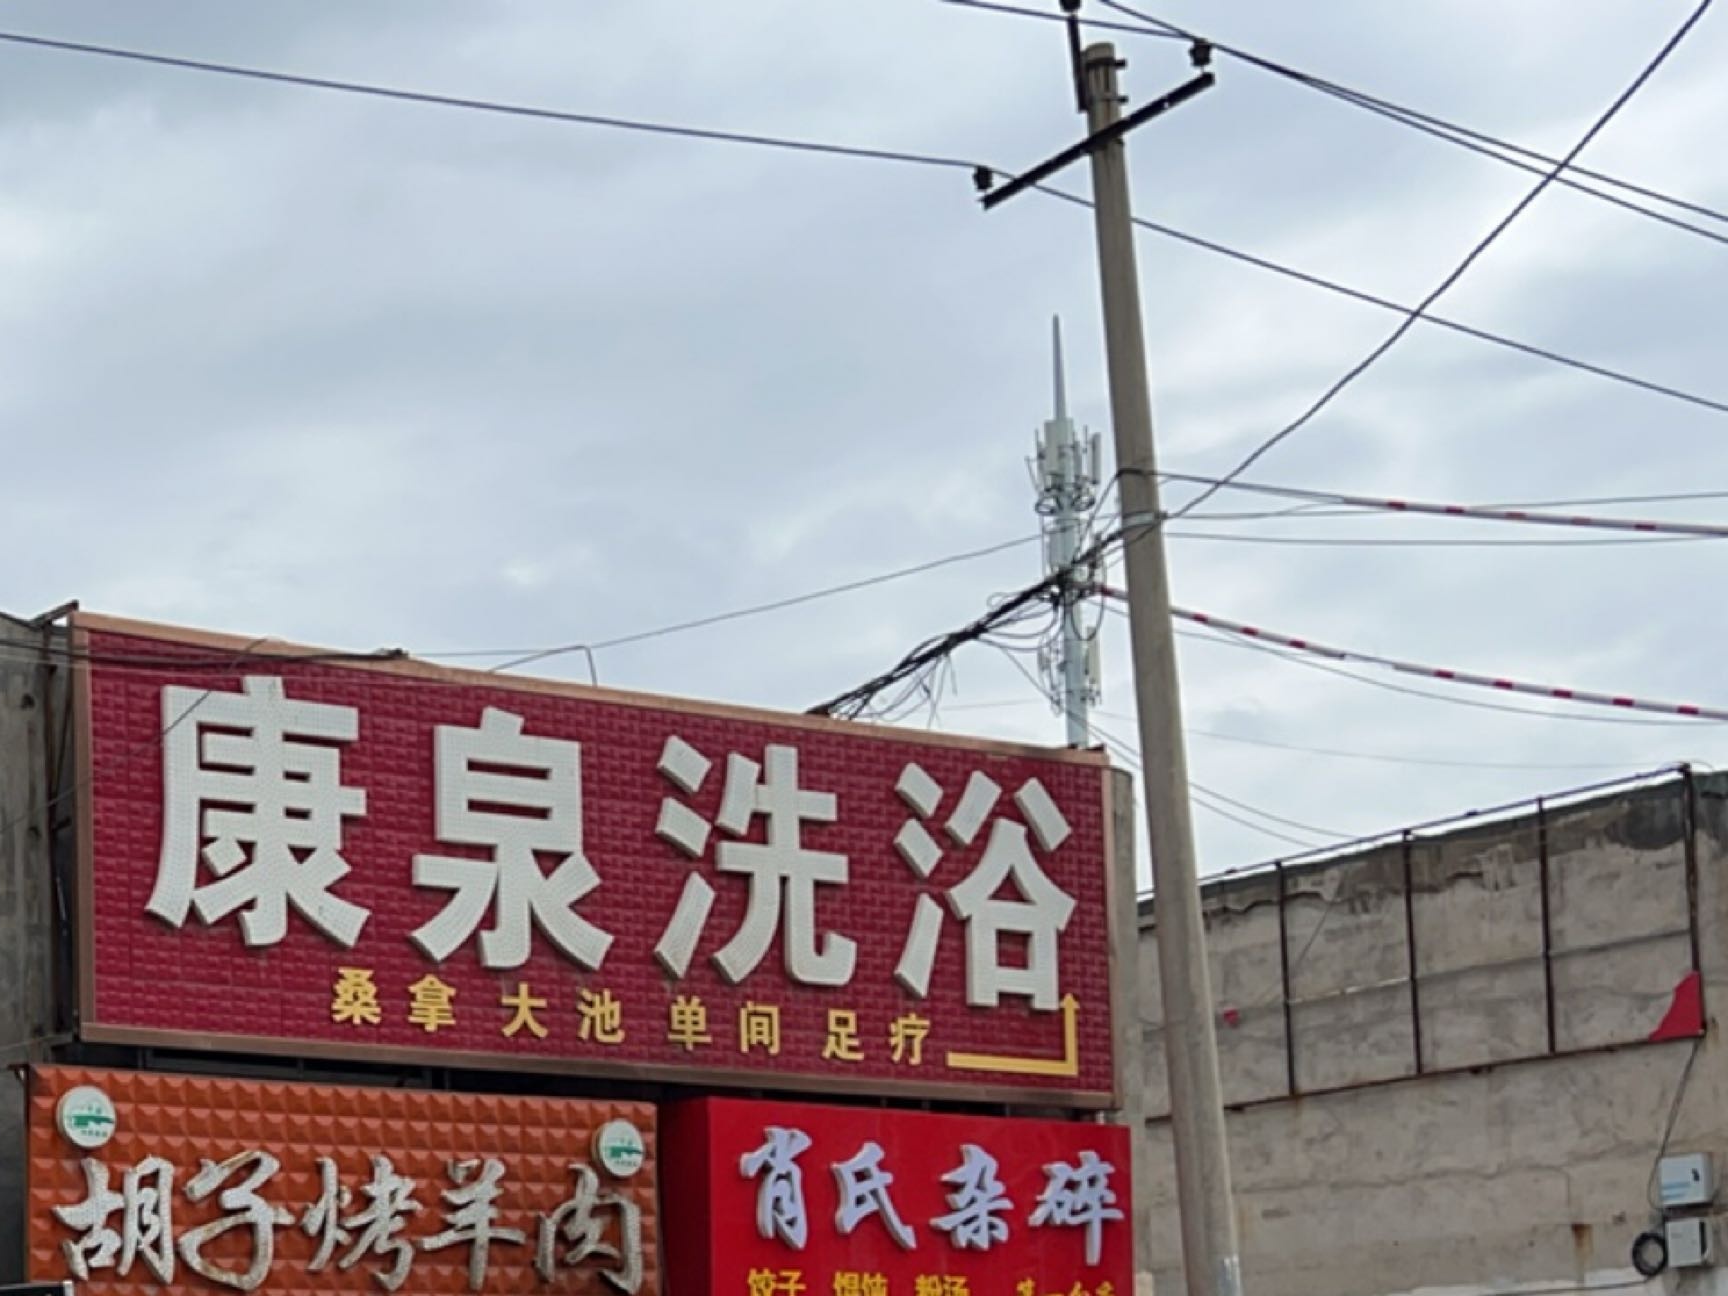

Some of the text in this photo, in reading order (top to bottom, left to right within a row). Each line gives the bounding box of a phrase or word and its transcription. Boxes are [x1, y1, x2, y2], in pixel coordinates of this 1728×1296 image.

[144, 676, 1074, 1011] 康泉洗浴
[53, 1150, 643, 1296] 胡子烤羊肉
[740, 1125, 1125, 1267] 肖氏杂碎
